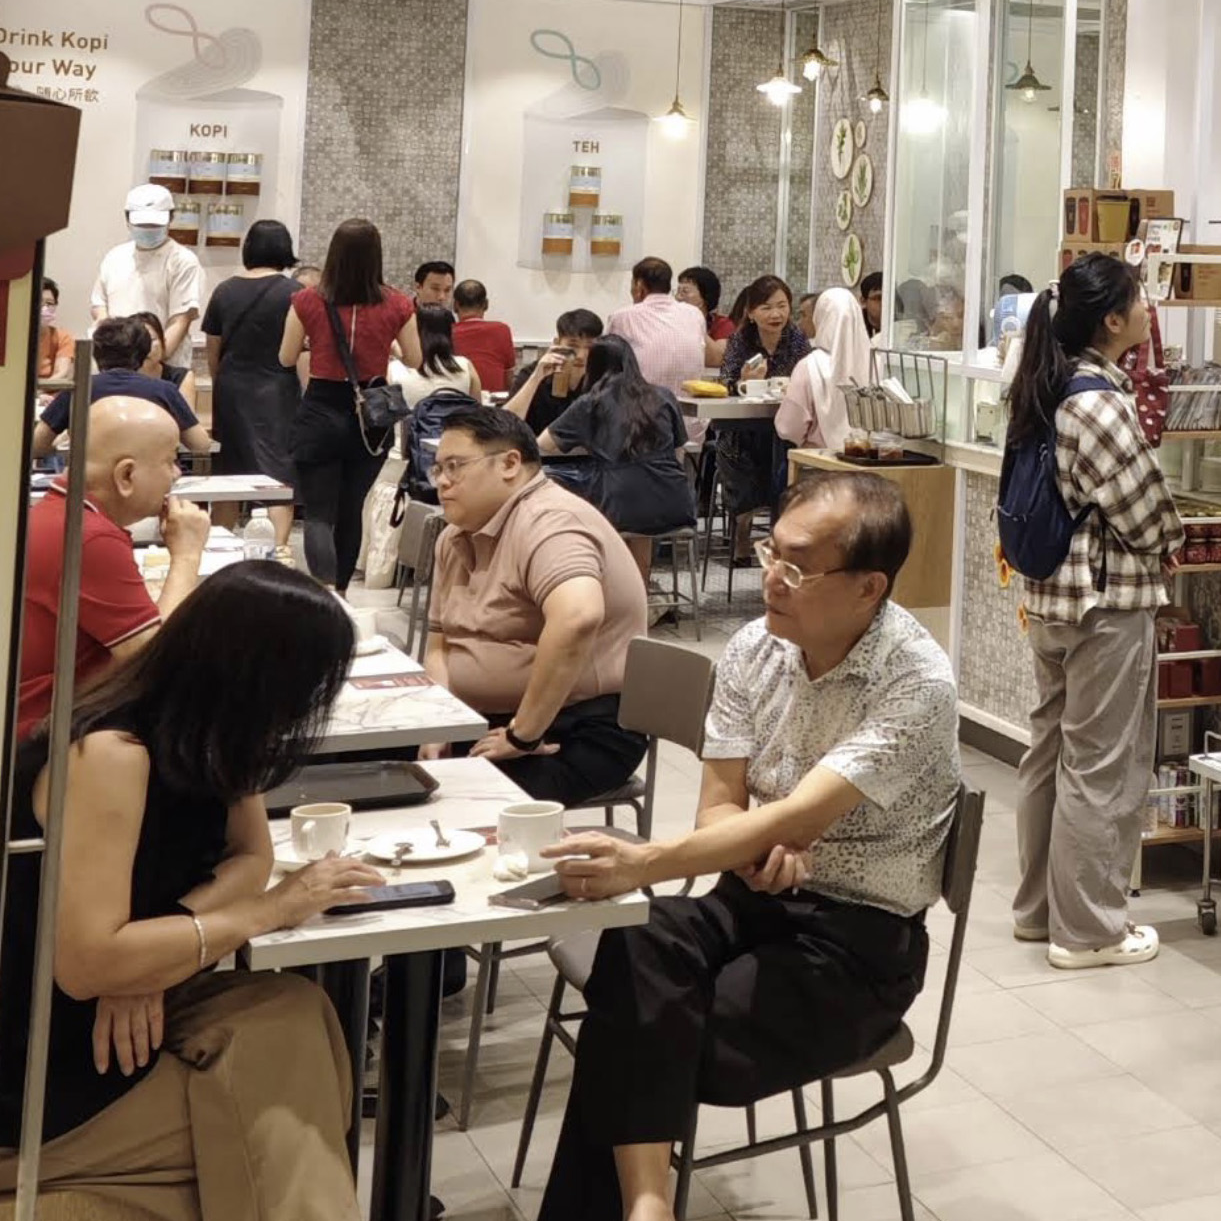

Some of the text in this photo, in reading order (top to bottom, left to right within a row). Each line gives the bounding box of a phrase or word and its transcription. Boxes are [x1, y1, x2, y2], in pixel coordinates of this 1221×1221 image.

[61, 31, 109, 54] Kopi
[9, 59, 97, 81] our Way
[190, 123, 228, 139] KOPI
[573, 140, 600, 154] TEH
